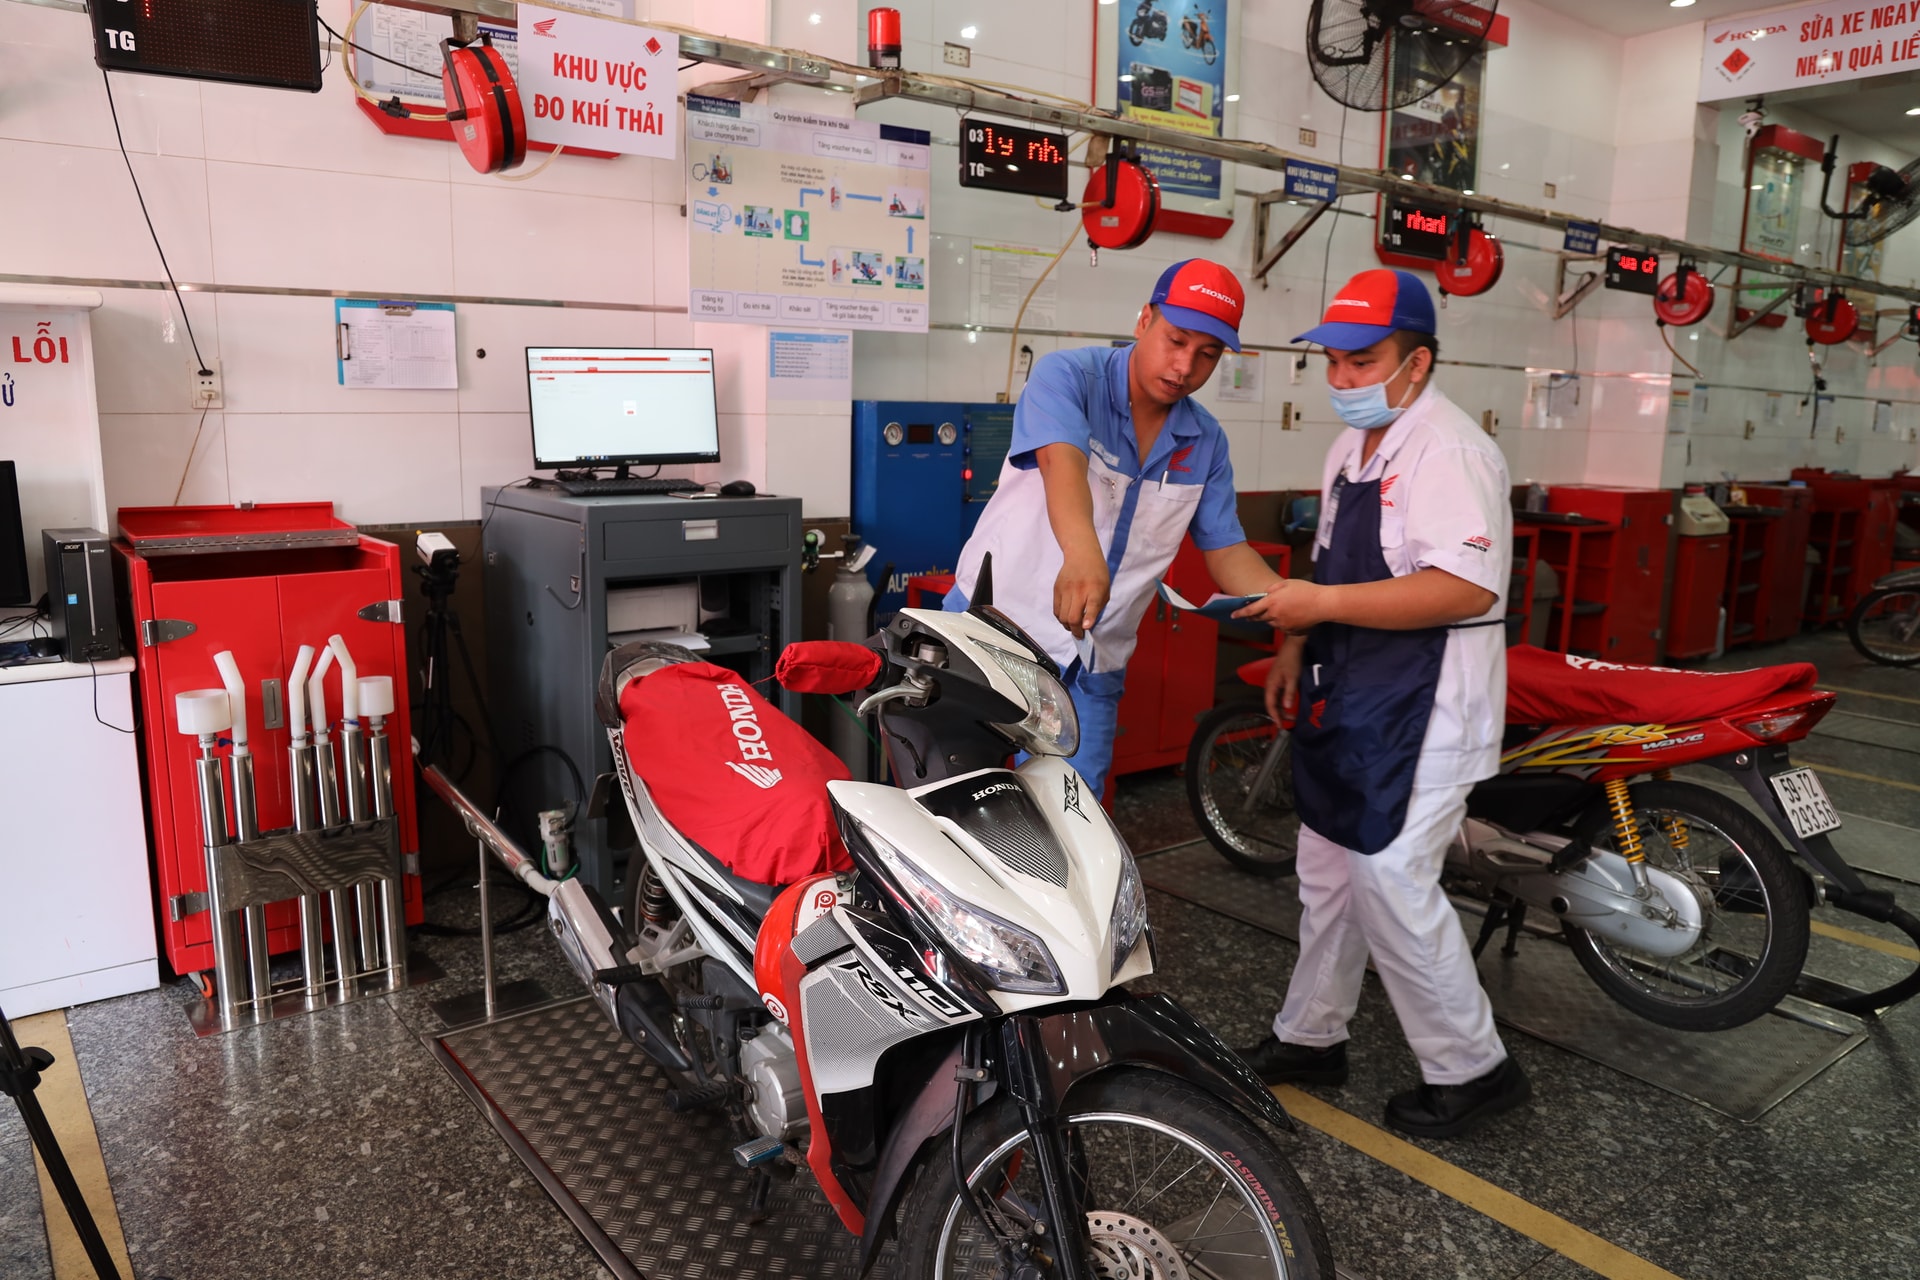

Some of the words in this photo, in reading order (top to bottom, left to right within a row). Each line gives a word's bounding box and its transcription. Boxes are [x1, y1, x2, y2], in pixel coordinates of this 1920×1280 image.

[1730, 25, 1788, 41] HODA
[1800, 13, 1833, 42] SỬA
[1840, 11, 1865, 35] XE
[1870, 0, 1920, 30] NGAY
[104, 28, 136, 51] TG
[1848, 40, 1883, 71] QUÀ
[553, 52, 598, 83] KHU
[605, 61, 647, 93] VỰC
[533, 93, 565, 121] ĐO
[572, 98, 610, 128] KHÍ
[615, 102, 663, 136] THẢI
[969, 129, 984, 143] 03
[969, 162, 985, 177] TG
[1149, 153, 1171, 163] Honda
[1201, 287, 1237, 308] HONDA
[12, 321, 69, 363] LỖI
[887, 571, 924, 594] ALP
[716, 683, 773, 761] HONDA
[971, 783, 1023, 801] HONDA
[1791, 799, 1837, 835] 293.56
[832, 958, 926, 1028] RSX
[896, 965, 962, 1015] 110
[1221, 1151, 1280, 1221] CASUMINA
[1274, 1221, 1295, 1258] TYRE
